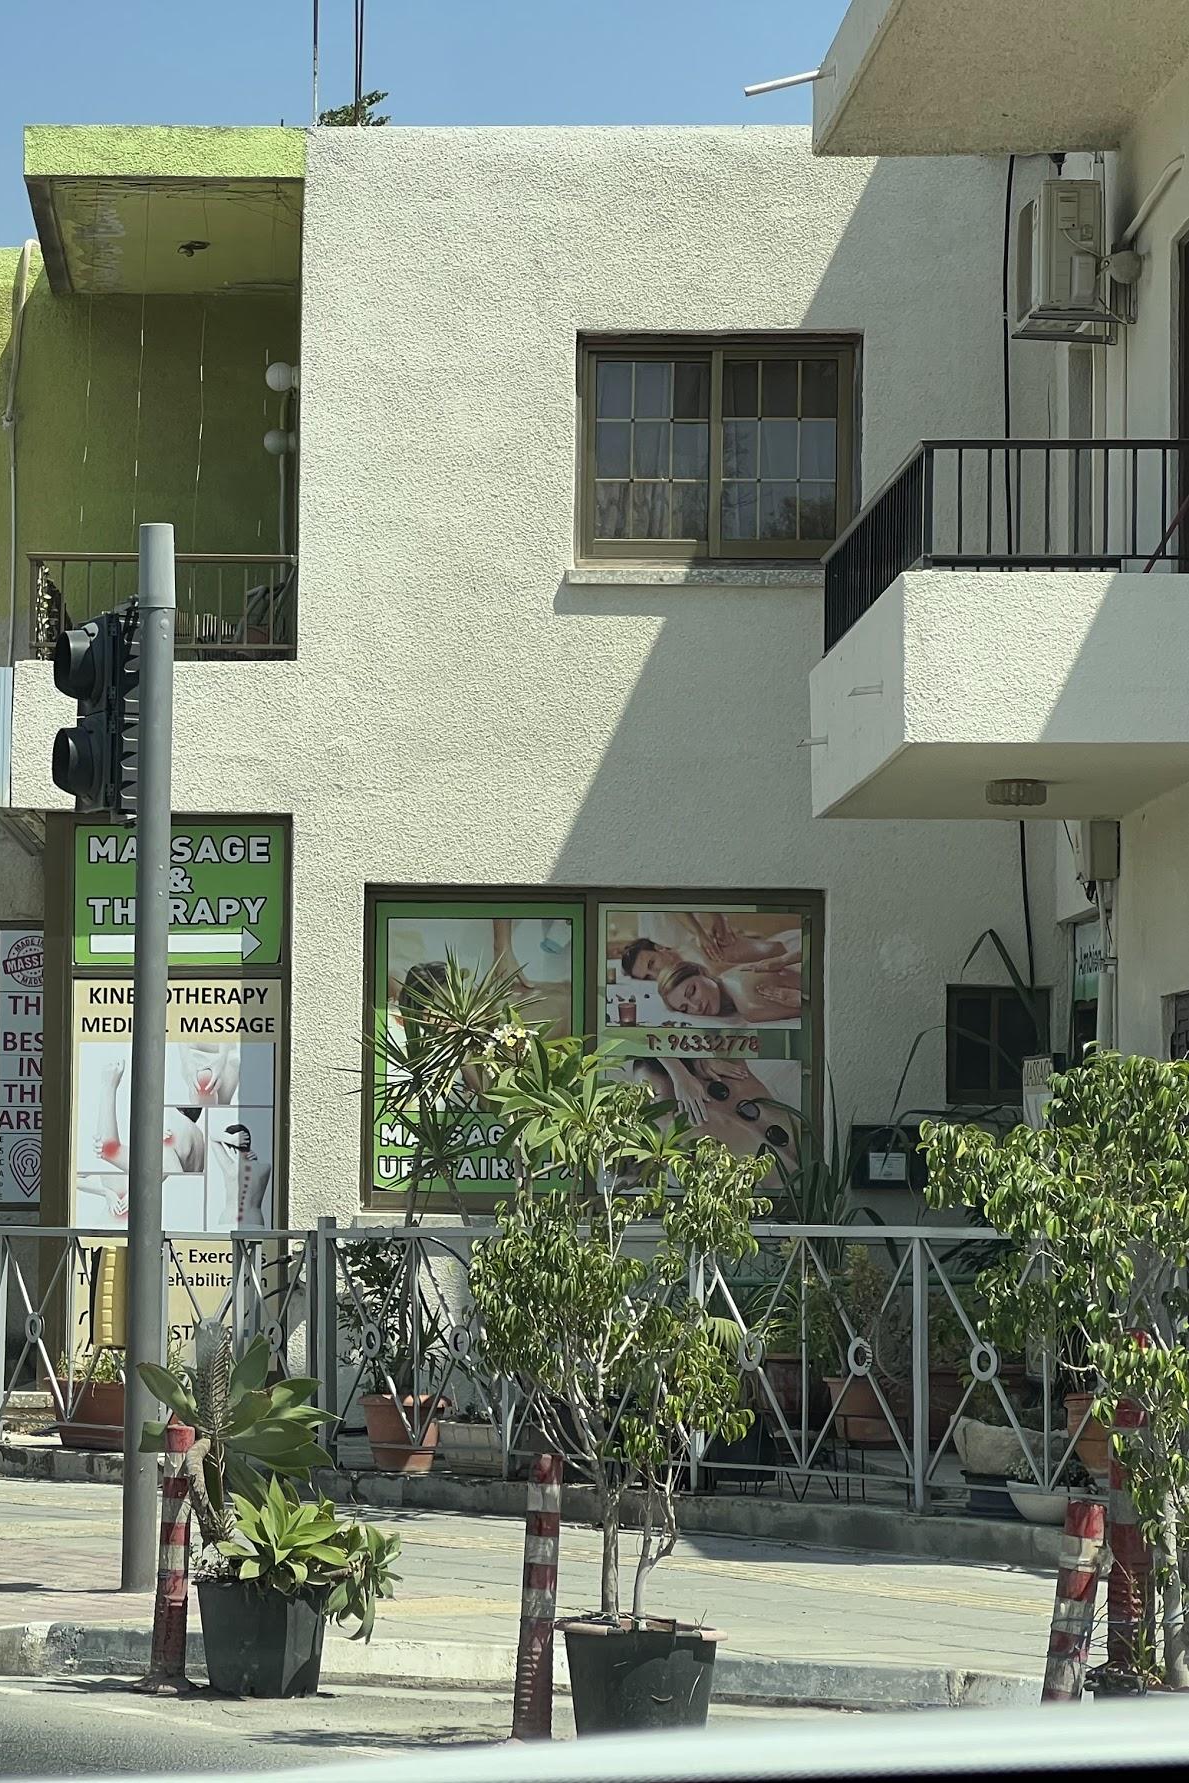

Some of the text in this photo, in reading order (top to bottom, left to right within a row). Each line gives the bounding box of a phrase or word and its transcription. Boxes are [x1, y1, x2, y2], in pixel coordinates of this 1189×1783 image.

[88, 836, 271, 863] MASAGE
[87, 897, 267, 924] THRAPY
[8, 995, 42, 1015] TH
[89, 987, 269, 1005] KINETHERAPY
[81, 1017, 276, 1033] MEDI MASSAGE
[3, 1032, 44, 1051] BES
[3, 1084, 43, 1103] TH
[380, 1123, 507, 1147] MASAG
